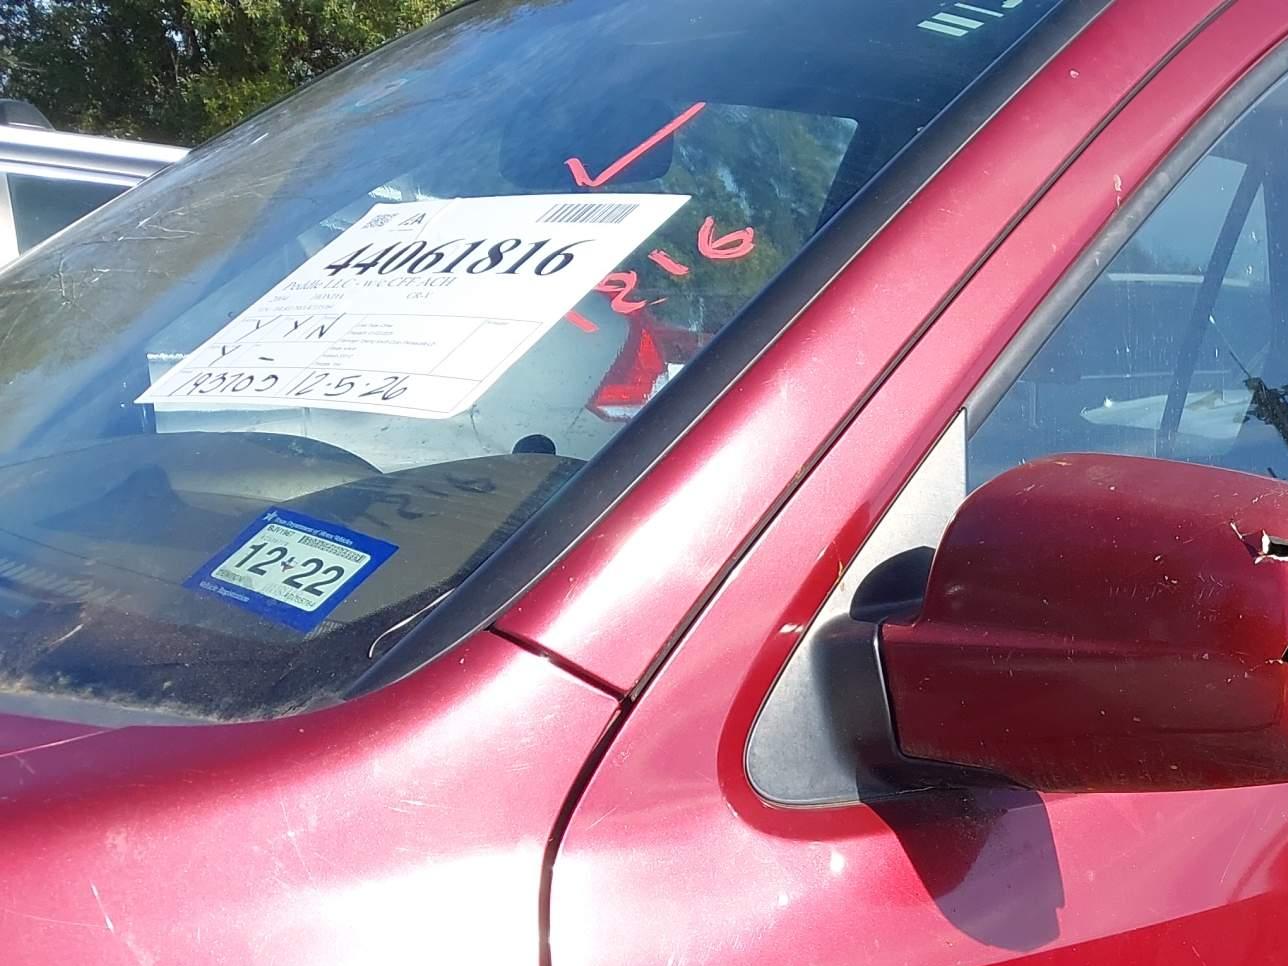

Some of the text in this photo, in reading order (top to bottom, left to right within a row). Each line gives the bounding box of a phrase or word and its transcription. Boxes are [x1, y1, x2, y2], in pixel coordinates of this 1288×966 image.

[324, 237, 597, 277] 44061816
[234, 541, 346, 597] 12 22
